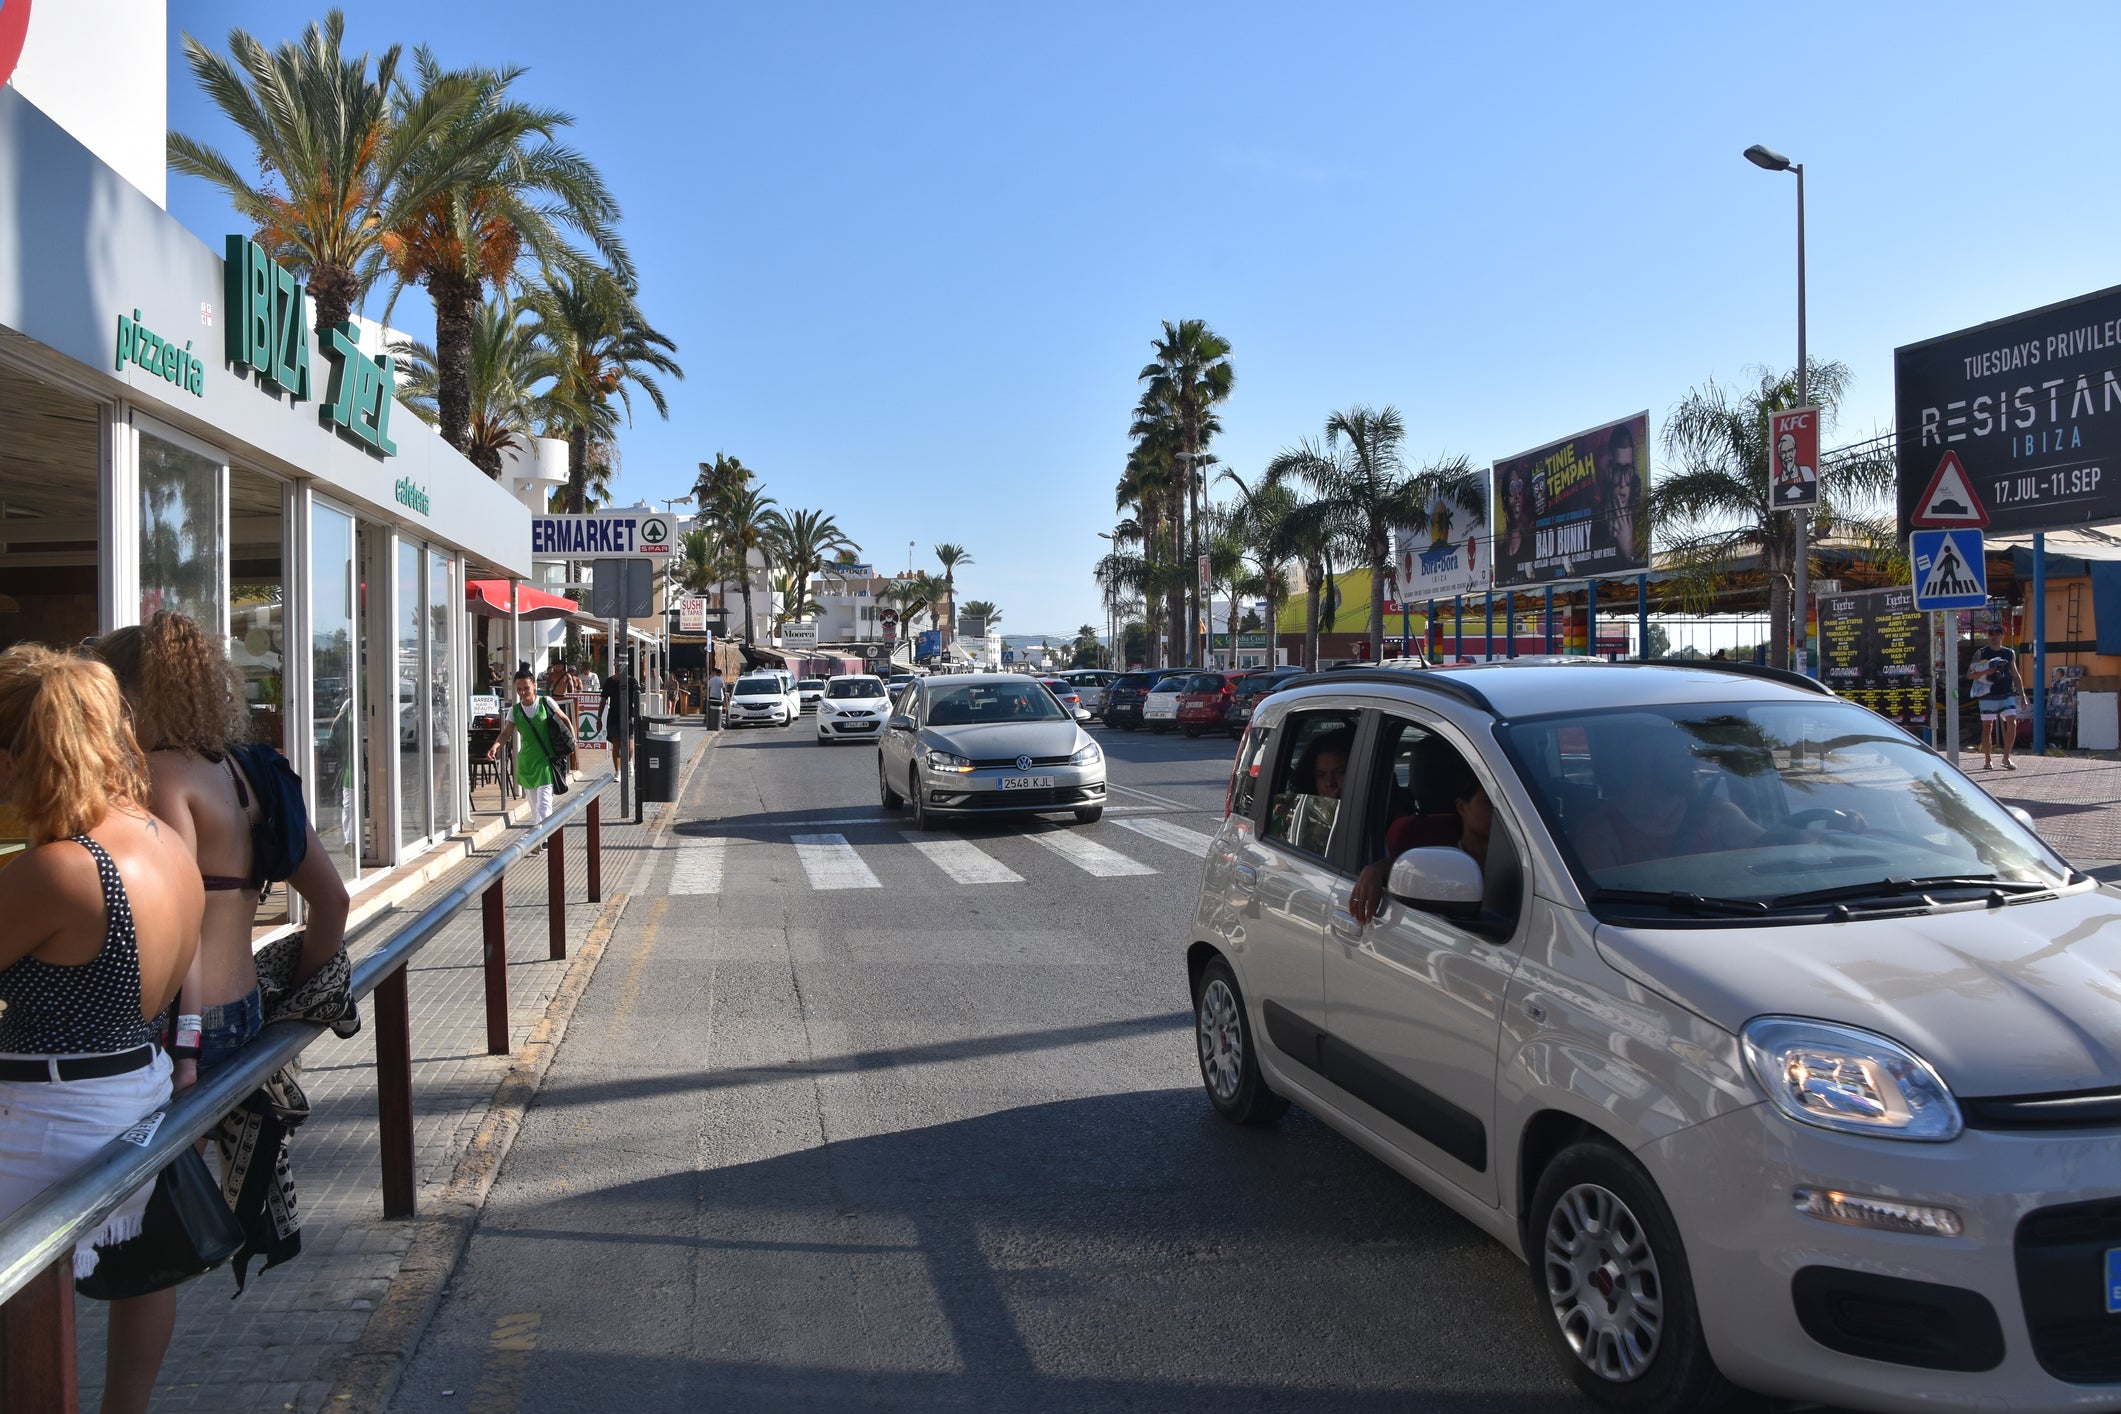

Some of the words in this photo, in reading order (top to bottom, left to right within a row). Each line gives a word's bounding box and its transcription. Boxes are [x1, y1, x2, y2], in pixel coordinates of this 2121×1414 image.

[225, 234, 311, 401] IBIZA
[116, 308, 204, 397] pizzería
[1964, 340, 2041, 381] TUESDAYS
[1779, 414, 1808, 432] KFC
[1545, 443, 1575, 476] TINIE
[2013, 426, 2081, 458] IBIZA
[1546, 452, 1595, 497] TEMPAH
[1536, 529, 1554, 560] BAD
[1557, 520, 1592, 555] BUNNY
[682, 600, 703, 610] SUSHI
[1004, 778, 1029, 789] 2548
[1033, 777, 1051, 787] KJL
